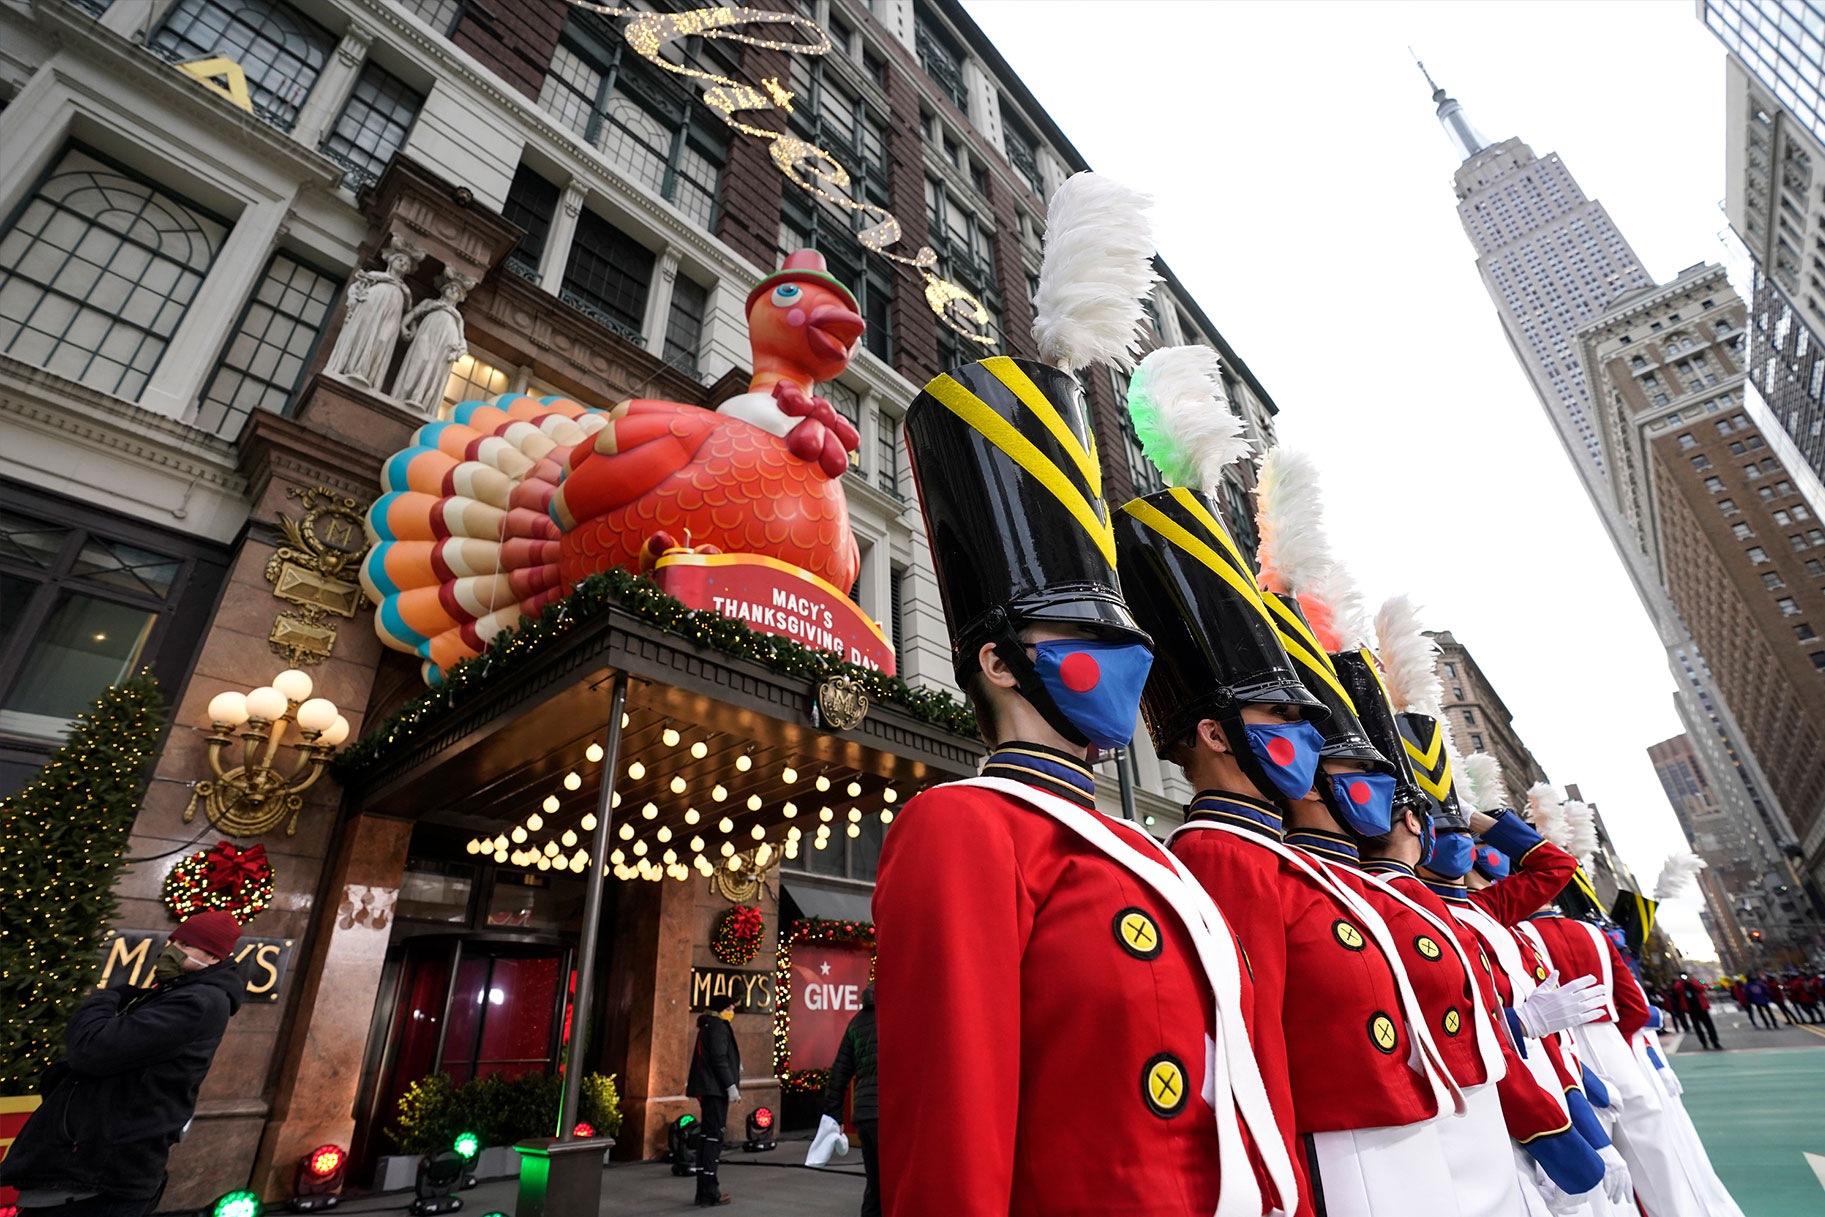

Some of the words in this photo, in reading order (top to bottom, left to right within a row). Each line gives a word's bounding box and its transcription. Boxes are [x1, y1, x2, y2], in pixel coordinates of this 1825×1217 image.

[772, 587, 833, 630] MACY'S
[712, 596, 844, 656] THANKSGIVING
[851, 646, 879, 672] DAY
[97, 936, 281, 994] M'S
[693, 971, 770, 1008] MACY'S
[804, 983, 864, 1011] GIVE.
